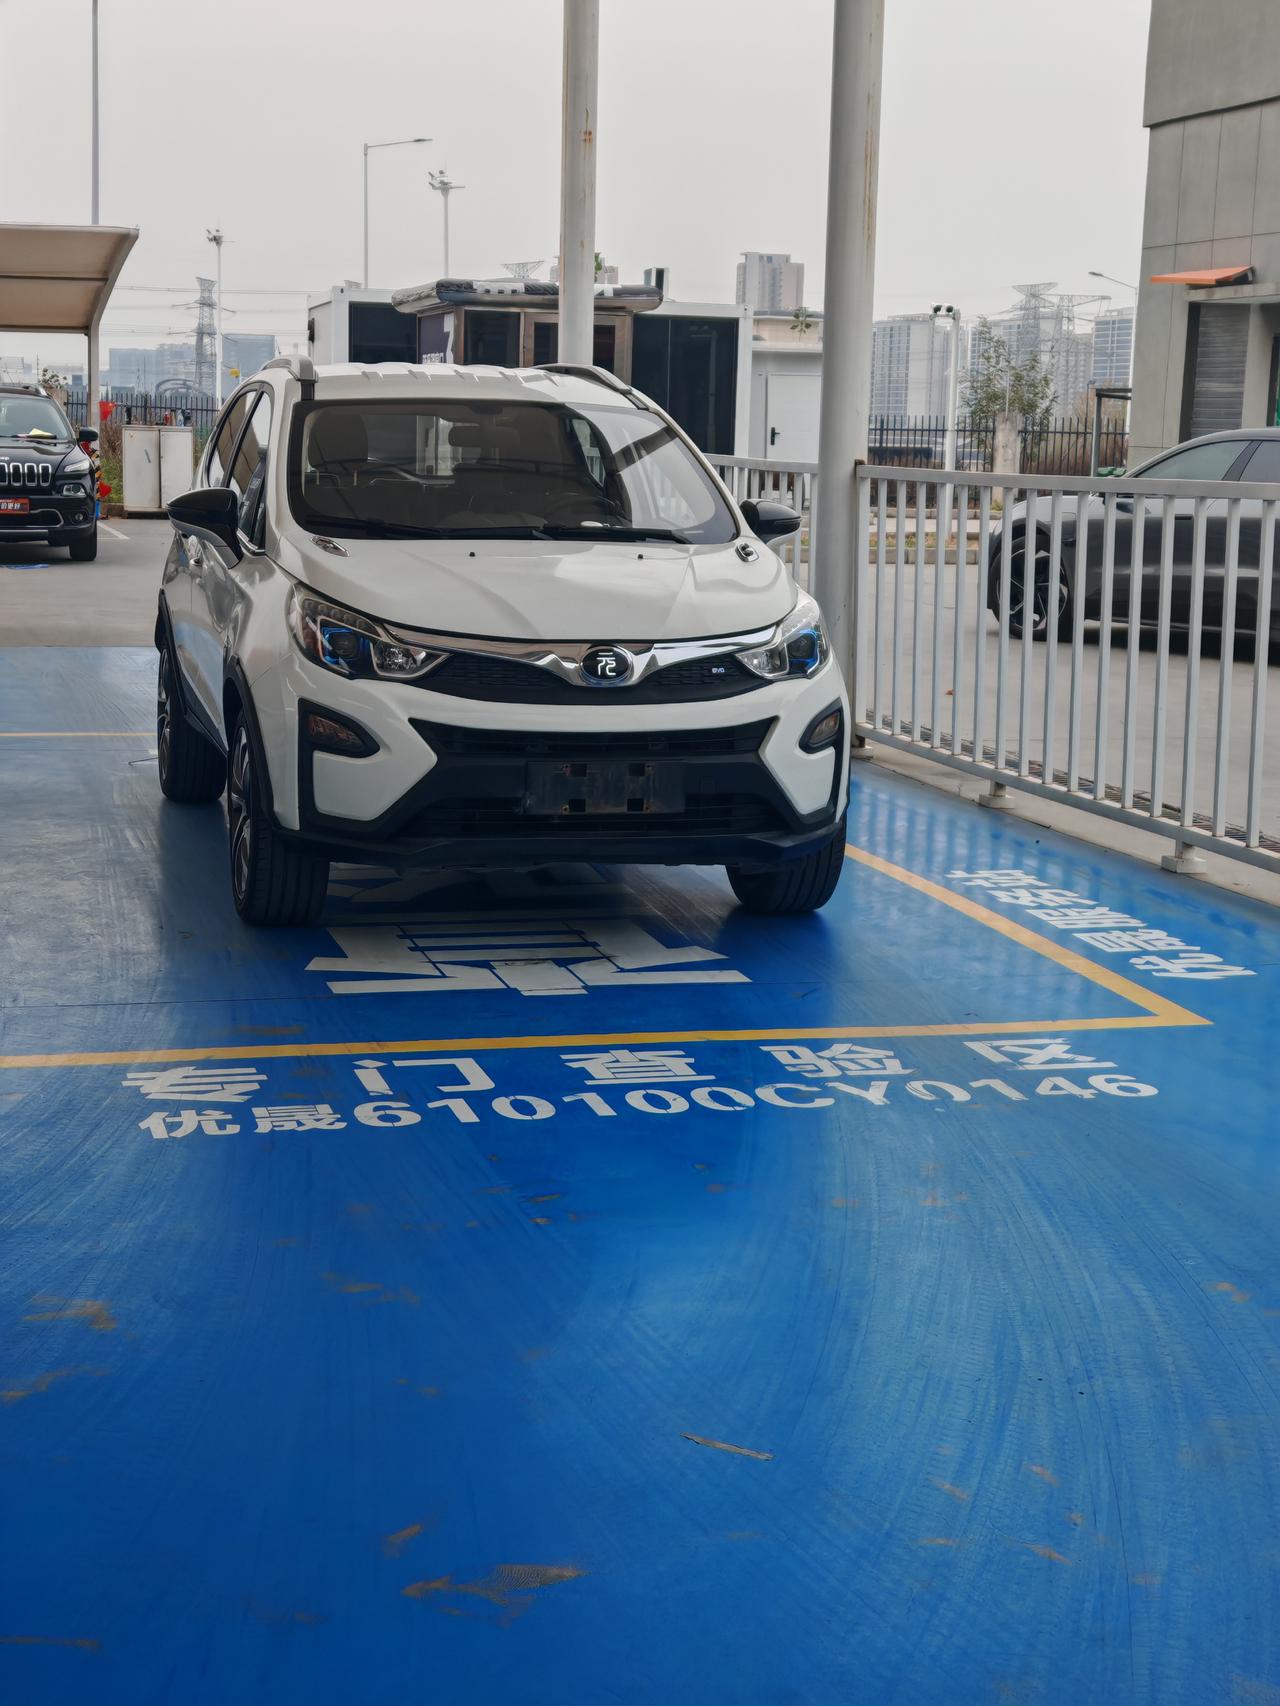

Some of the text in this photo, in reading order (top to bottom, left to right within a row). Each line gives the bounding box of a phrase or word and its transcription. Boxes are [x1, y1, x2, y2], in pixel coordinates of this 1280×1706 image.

[597, 652, 616, 676] 元
[945, 869, 1258, 980] 优晟服务站
[121, 1038, 1119, 1103] 专门查验区
